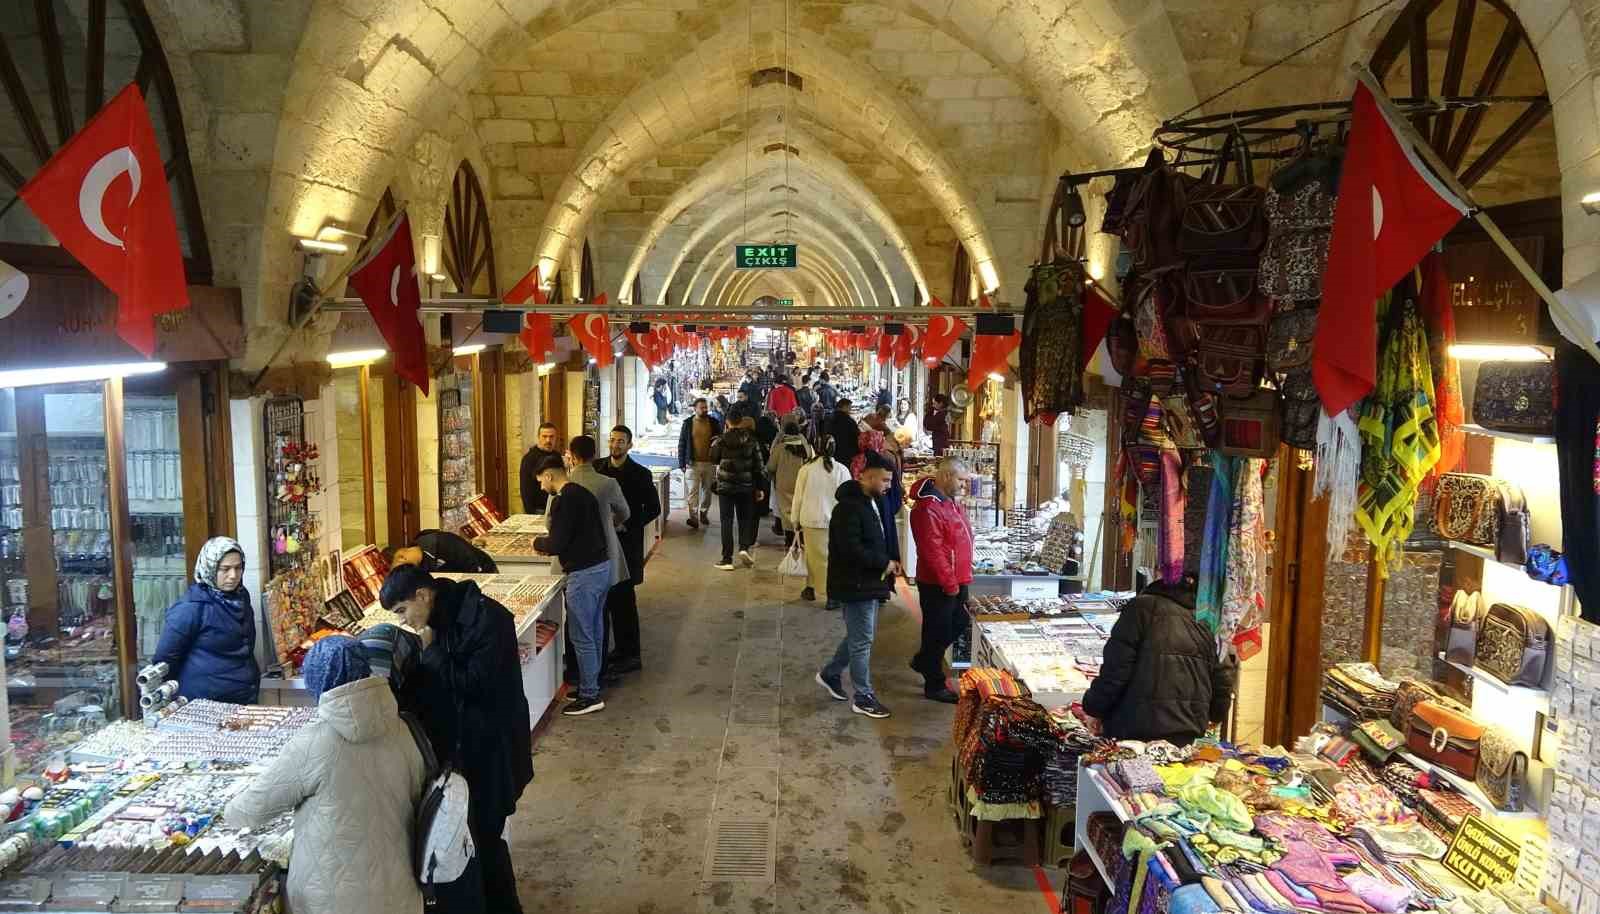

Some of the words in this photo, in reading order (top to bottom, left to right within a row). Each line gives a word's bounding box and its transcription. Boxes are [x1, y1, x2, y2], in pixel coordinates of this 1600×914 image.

[744, 247, 789, 257] EXIT
[744, 257, 788, 267] ÇIKIŞ
[1447, 850, 1494, 887] KUTN
